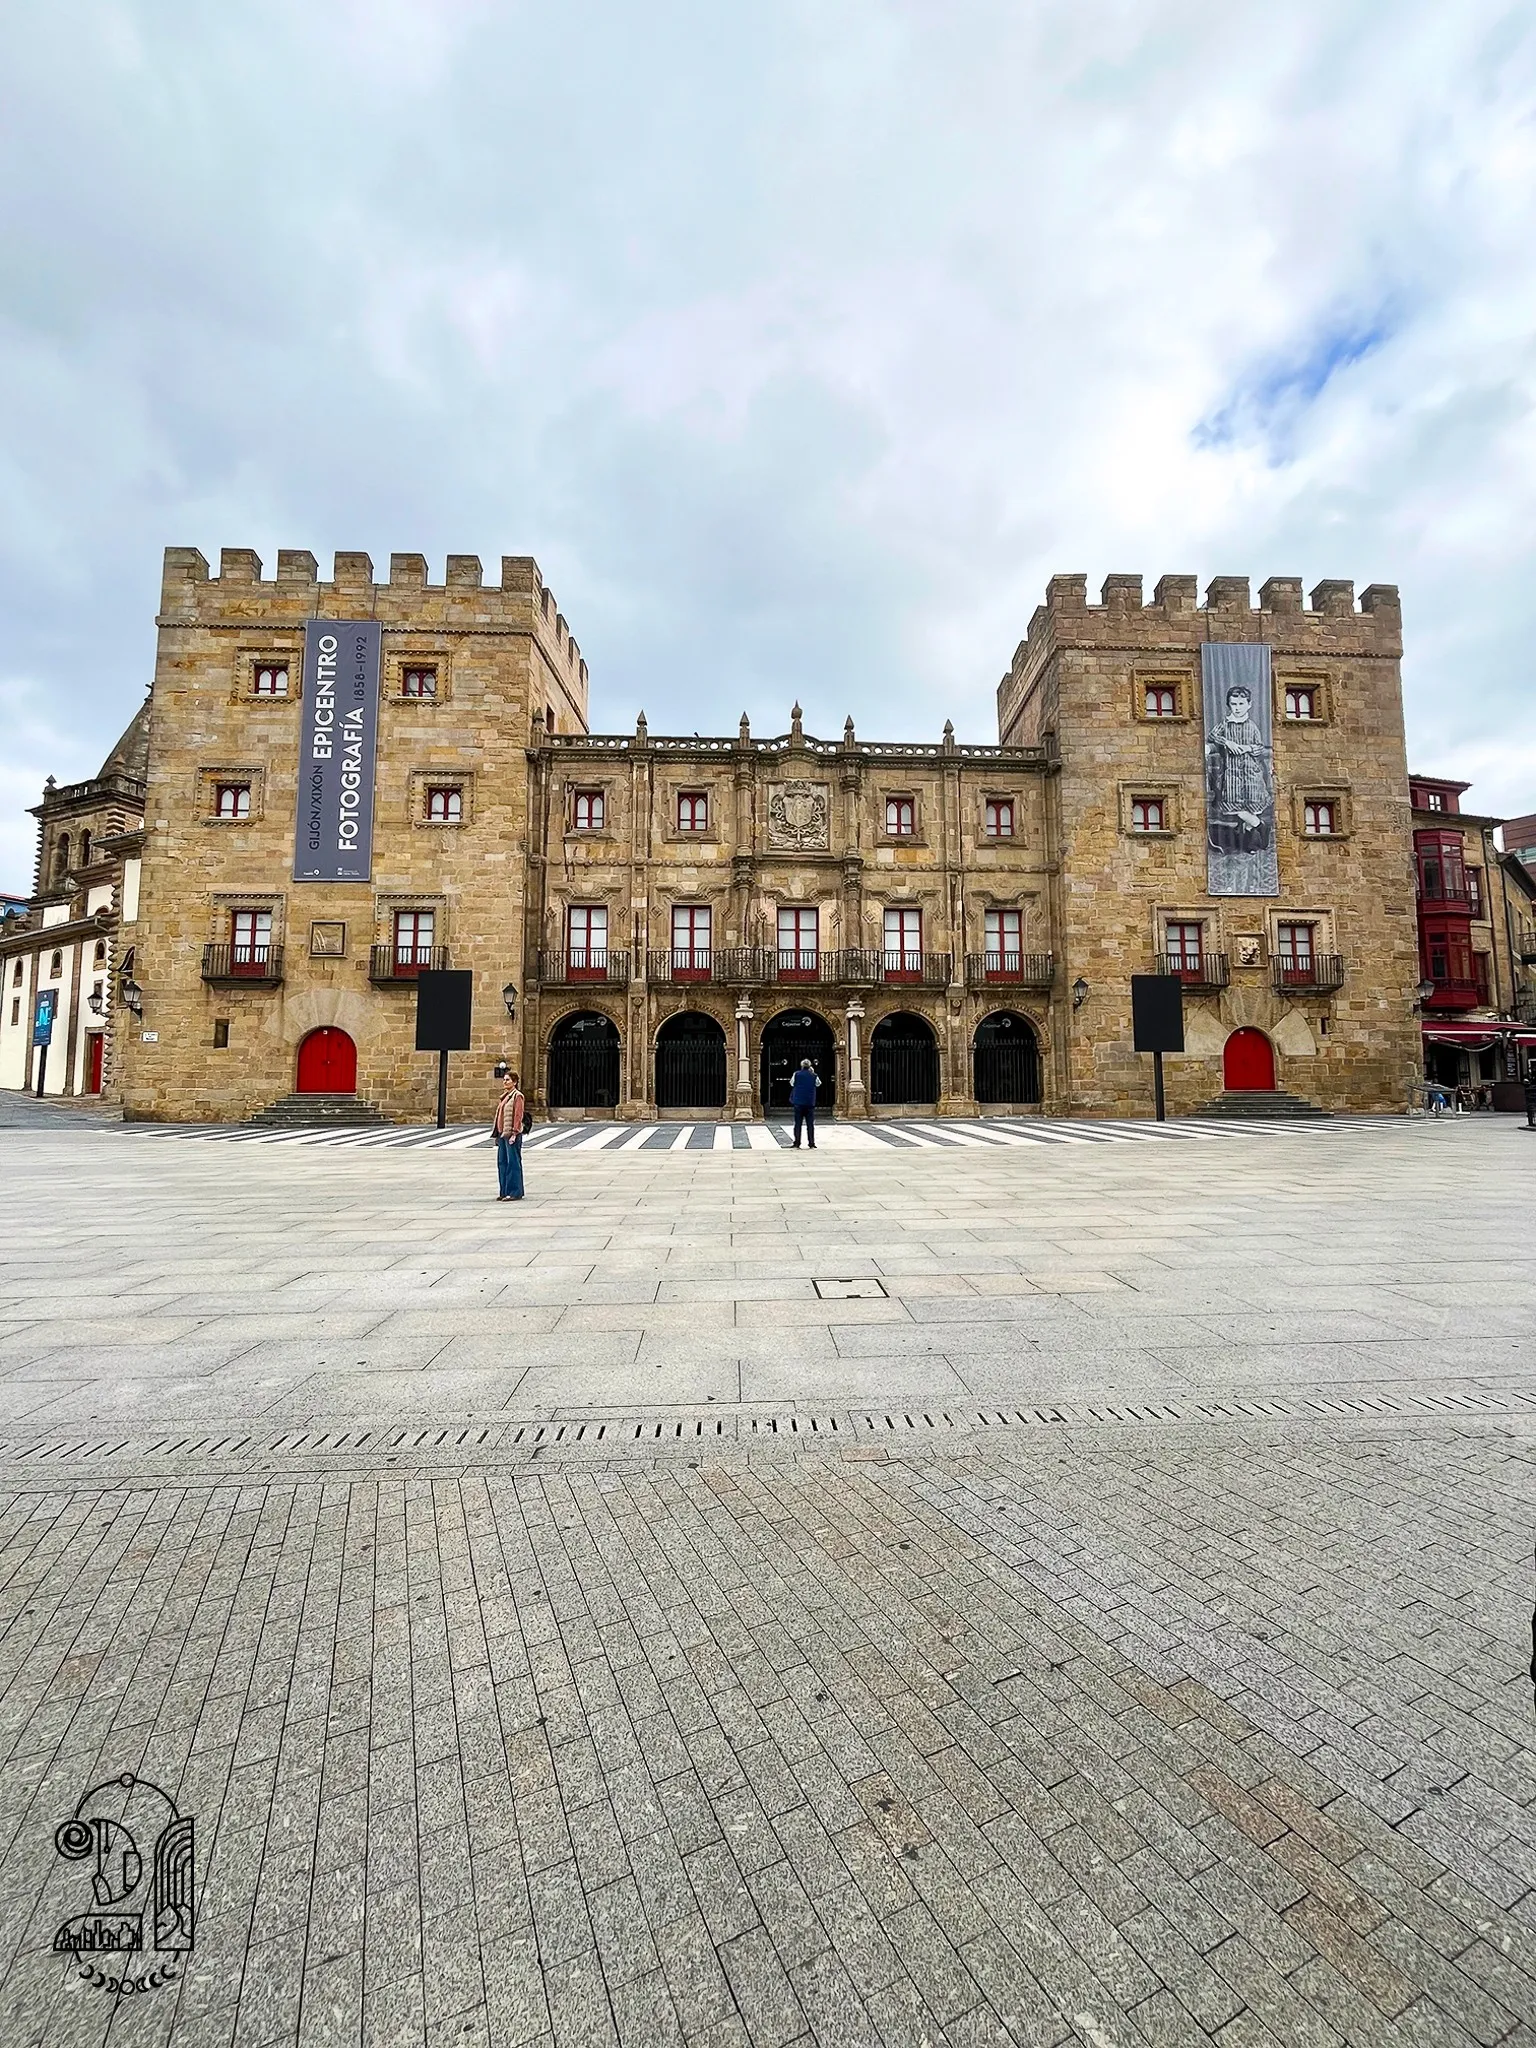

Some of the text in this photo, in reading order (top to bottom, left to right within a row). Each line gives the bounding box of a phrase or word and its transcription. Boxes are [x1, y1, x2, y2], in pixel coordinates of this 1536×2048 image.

[312, 635, 338, 759] EPICENTRO
[337, 706, 364, 850] FOTOGRAFÍA
[353, 636, 367, 701] 1858-1992
[307, 765, 323, 850] GIJÓN/XIXÓN
